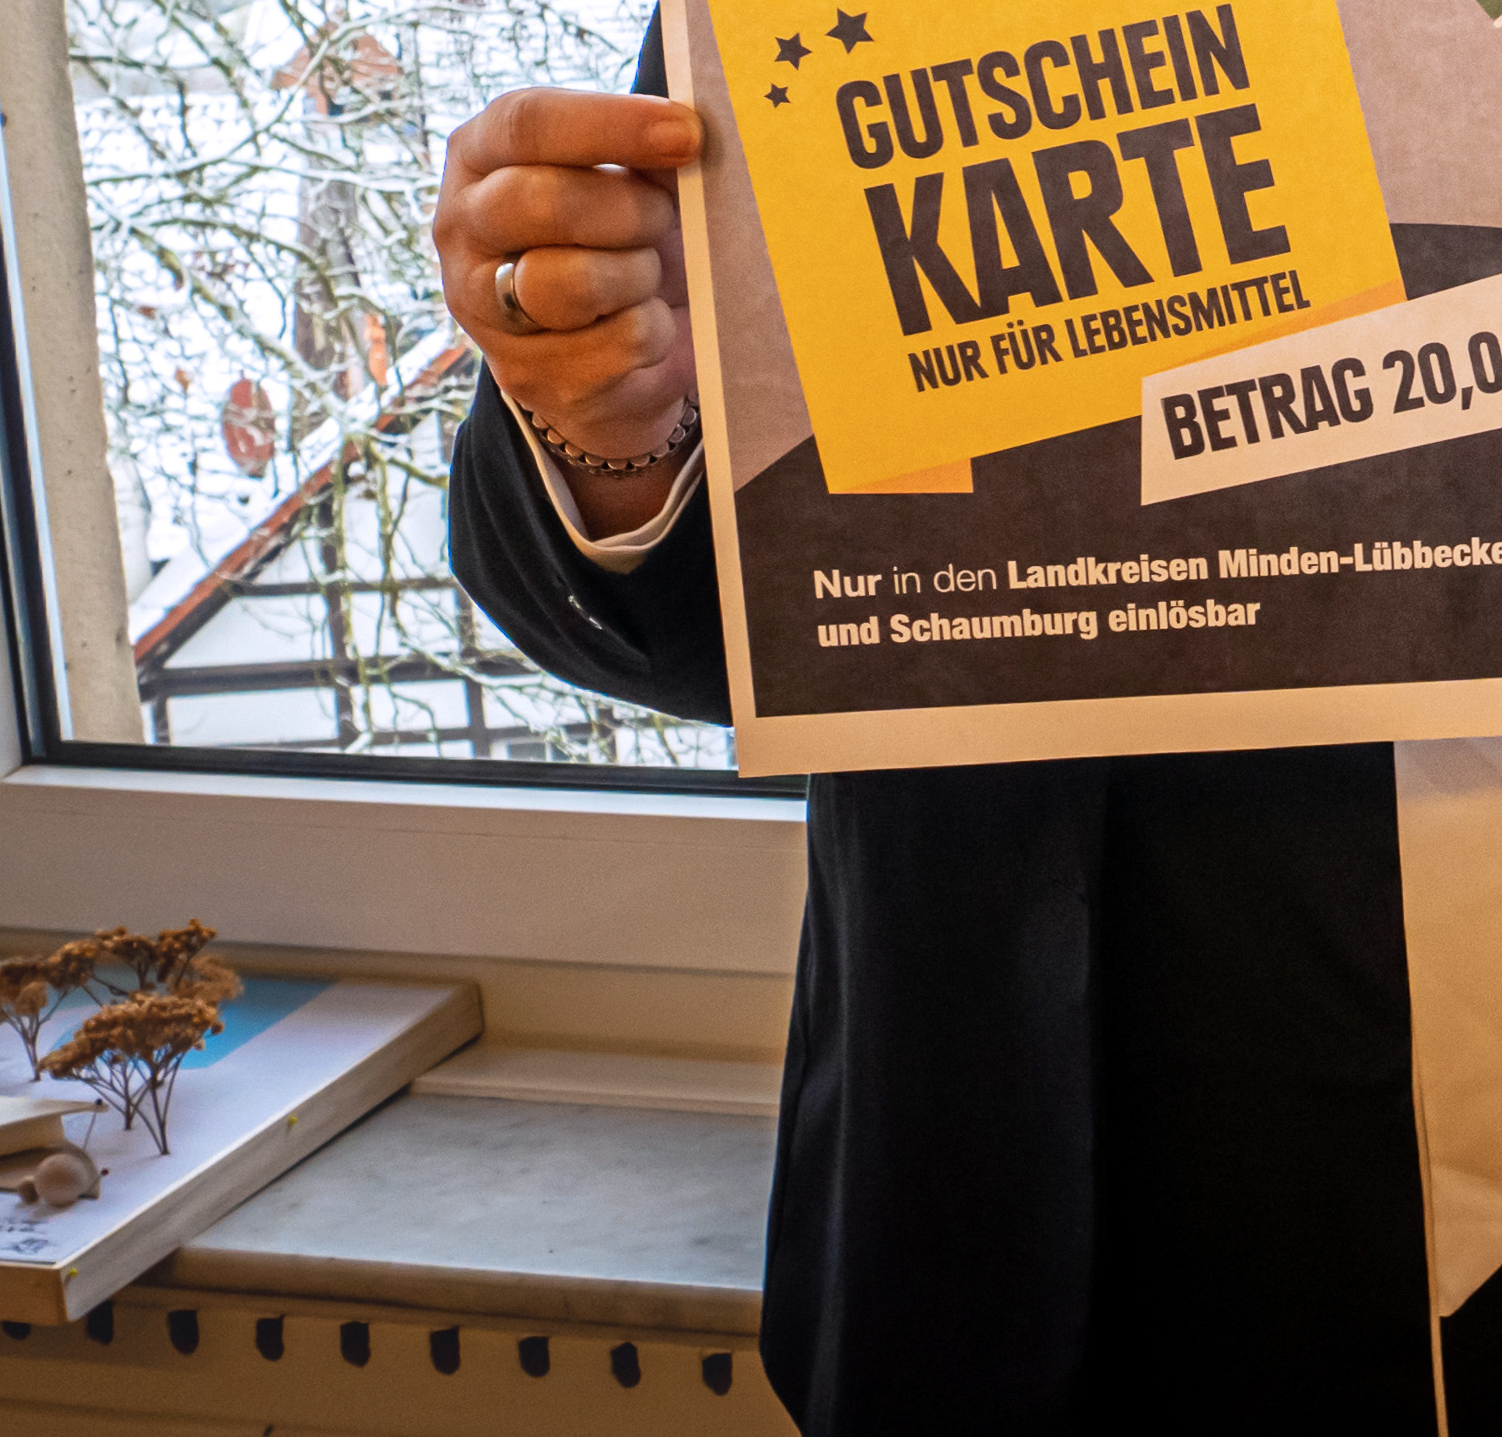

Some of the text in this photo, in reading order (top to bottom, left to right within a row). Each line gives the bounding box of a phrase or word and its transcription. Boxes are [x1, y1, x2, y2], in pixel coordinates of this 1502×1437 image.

[836, 3, 1250, 169] GUTSCHEIN
[864, 103, 1292, 337] KARTE
[908, 269, 1311, 392] NUR FÜR LEBENSMITTEL
[1160, 357, 1374, 460] BETRAG
[813, 568, 881, 599] Nur
[892, 566, 920, 594] in
[933, 563, 997, 593] den
[1007, 553, 1209, 590] Landkreisen
[817, 597, 1261, 647] und Schaumburg einlösbar
